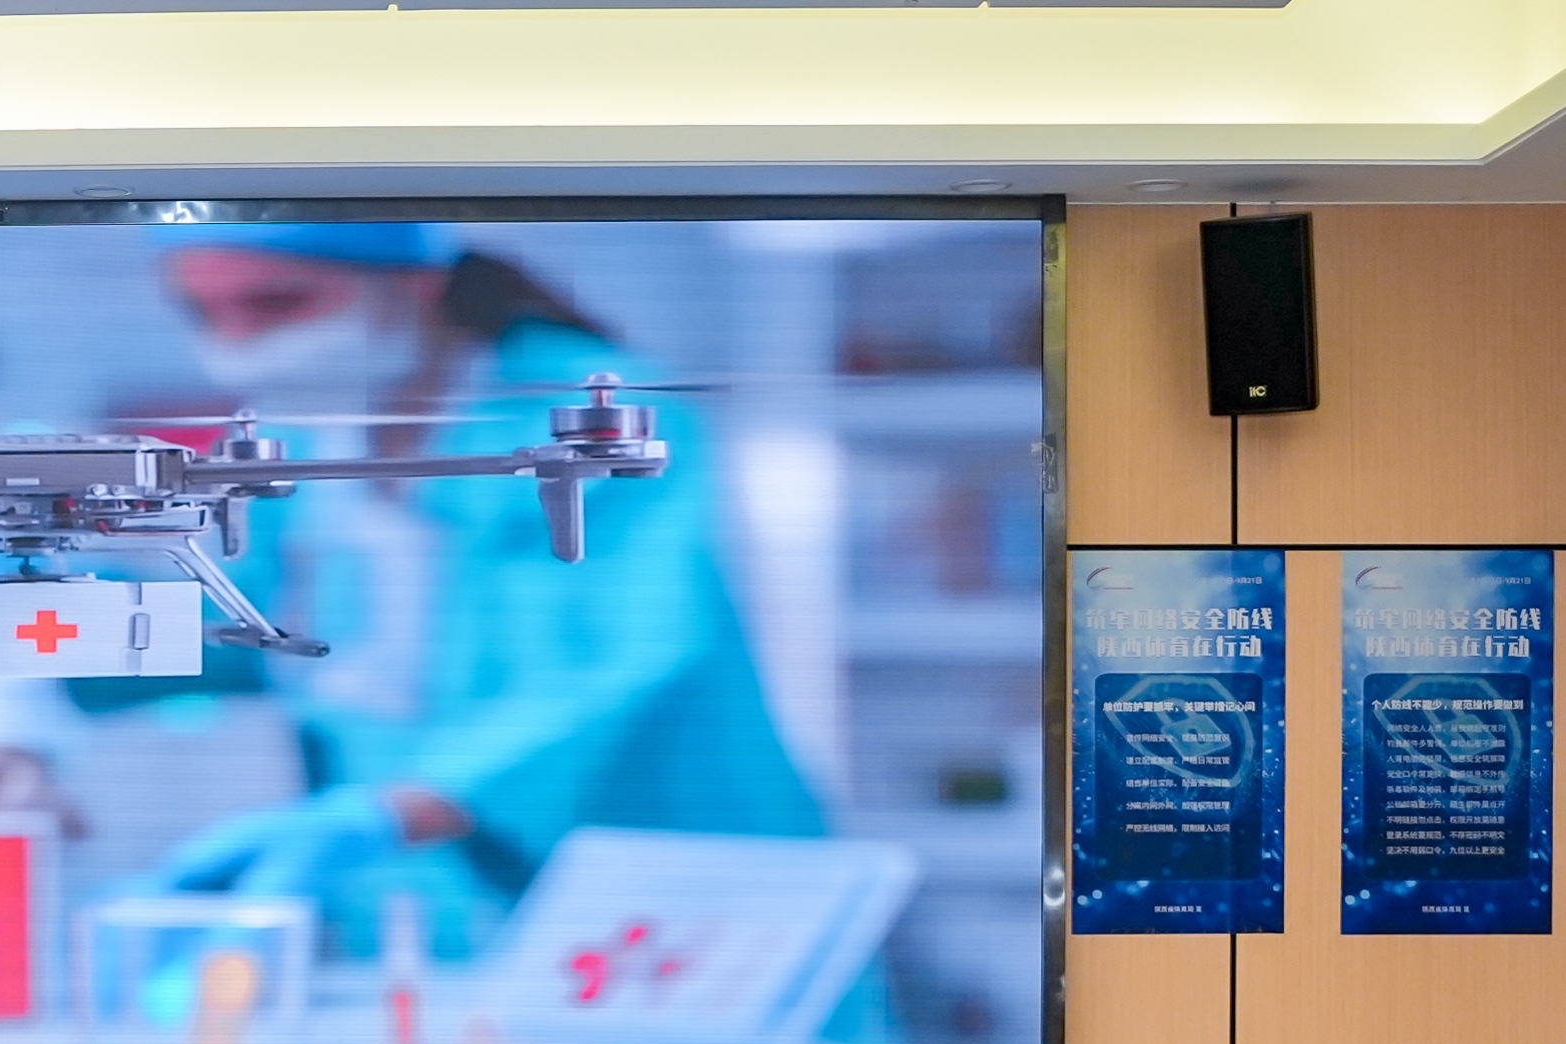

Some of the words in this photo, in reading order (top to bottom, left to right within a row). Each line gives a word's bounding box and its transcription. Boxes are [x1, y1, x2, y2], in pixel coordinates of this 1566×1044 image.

[1086, 608, 1273, 630] 筑牢网络安全防线
[1354, 608, 1541, 630] 筑牢网络安全防线
[1097, 635, 1262, 658] 陕西体育在行动
[1366, 635, 1530, 658] 陕西体育在行动
